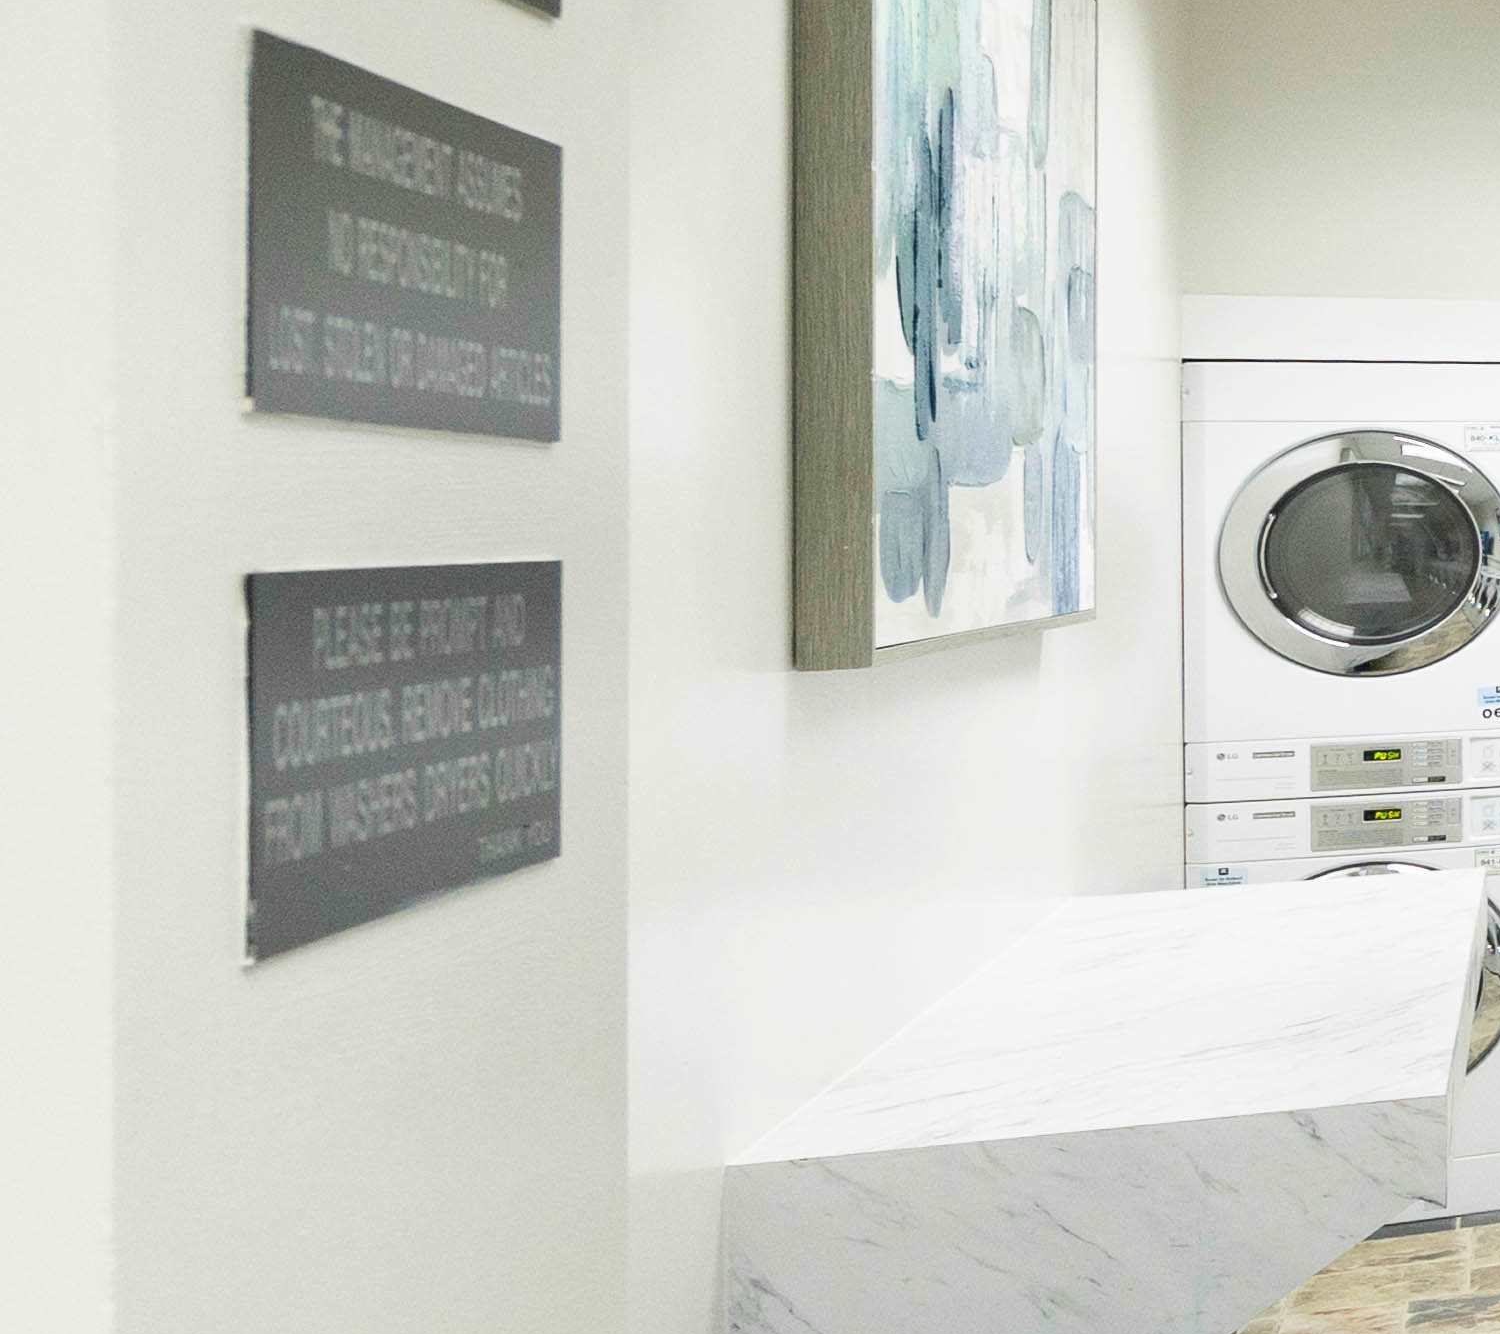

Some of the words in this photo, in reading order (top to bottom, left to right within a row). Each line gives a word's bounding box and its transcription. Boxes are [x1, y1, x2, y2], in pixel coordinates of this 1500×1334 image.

[311, 95, 343, 167] THE
[348, 110, 451, 201] MANAGEMENT
[457, 148, 523, 224] ASSUMES
[328, 209, 353, 277] NO
[357, 215, 475, 303] RESPONSIBILITY
[479, 249, 506, 309] FOR
[390, 325, 411, 388] OR
[417, 330, 486, 398] DAMAGED
[490, 343, 551, 407] ARTICLES
[313, 603, 382, 671] PLEASE
[390, 601, 413, 662] BE
[420, 595, 487, 658] PROMPT
[492, 593, 525, 649] AND
[402, 676, 471, 745] REMOVE
[478, 664, 554, 730] CLOTHING
[264, 790, 322, 867] FROM
[424, 752, 489, 824] DRYERS
